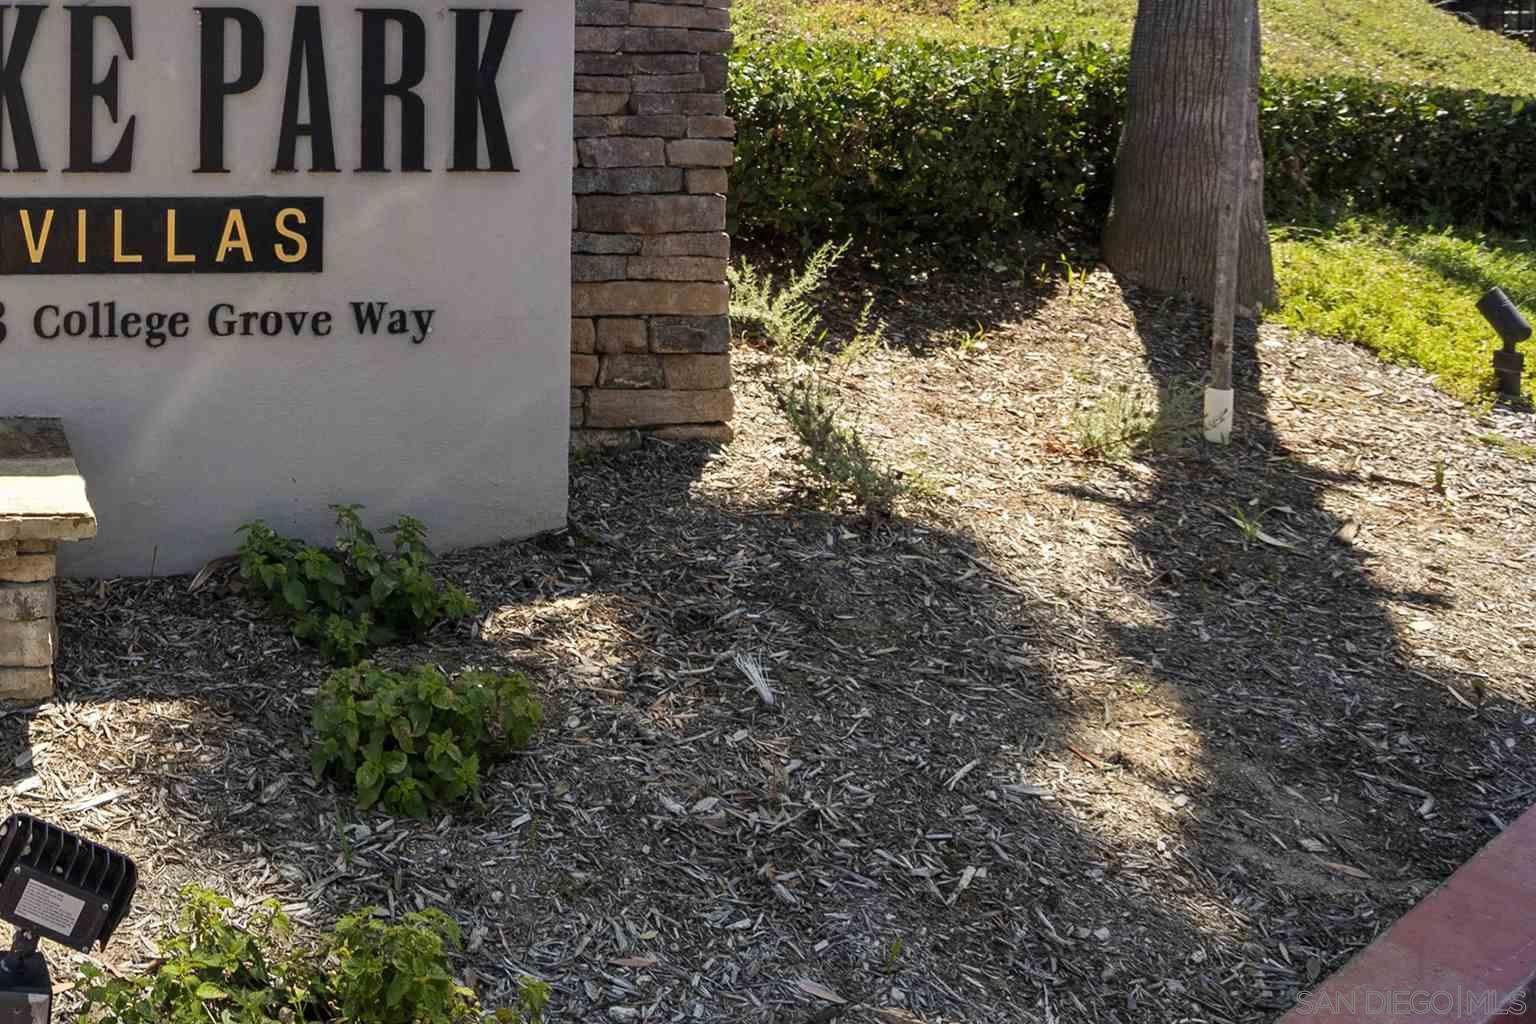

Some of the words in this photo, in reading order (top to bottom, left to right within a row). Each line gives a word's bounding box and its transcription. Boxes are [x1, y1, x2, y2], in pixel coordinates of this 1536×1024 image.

[192, 5, 524, 173] PARK
[19, 207, 309, 264] VILLAS
[33, 302, 190, 348] College
[207, 305, 333, 339] Grove
[350, 301, 436, 345] Way
